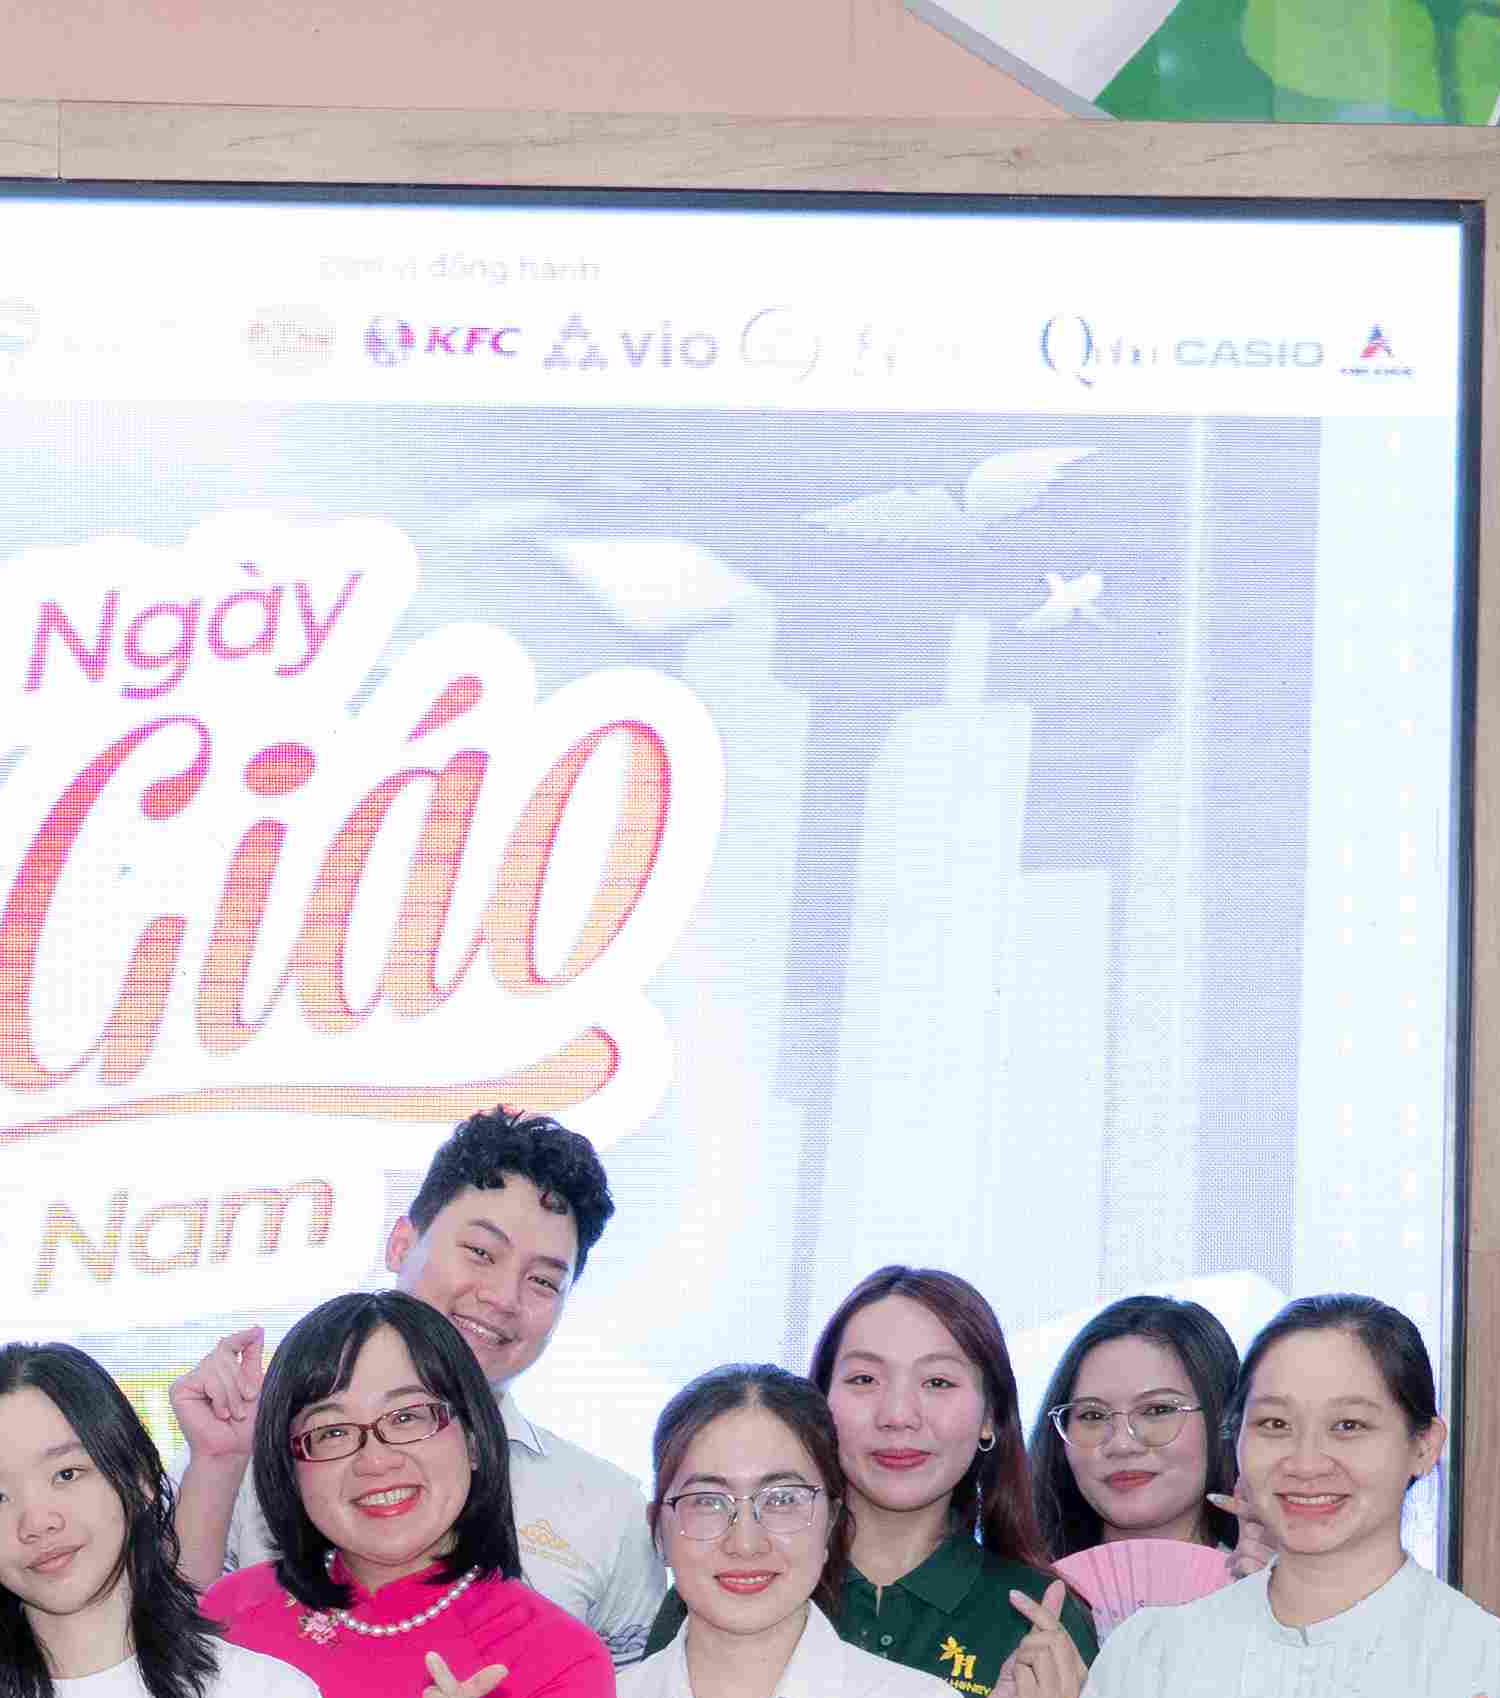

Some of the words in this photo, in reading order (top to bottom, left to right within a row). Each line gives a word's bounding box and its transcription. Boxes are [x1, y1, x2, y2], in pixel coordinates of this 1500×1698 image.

[424, 323, 521, 357] KFC
[1174, 337, 1325, 369] CASIO
[25, 565, 362, 701] Ngày
[32, 1178, 336, 1295] Nam
